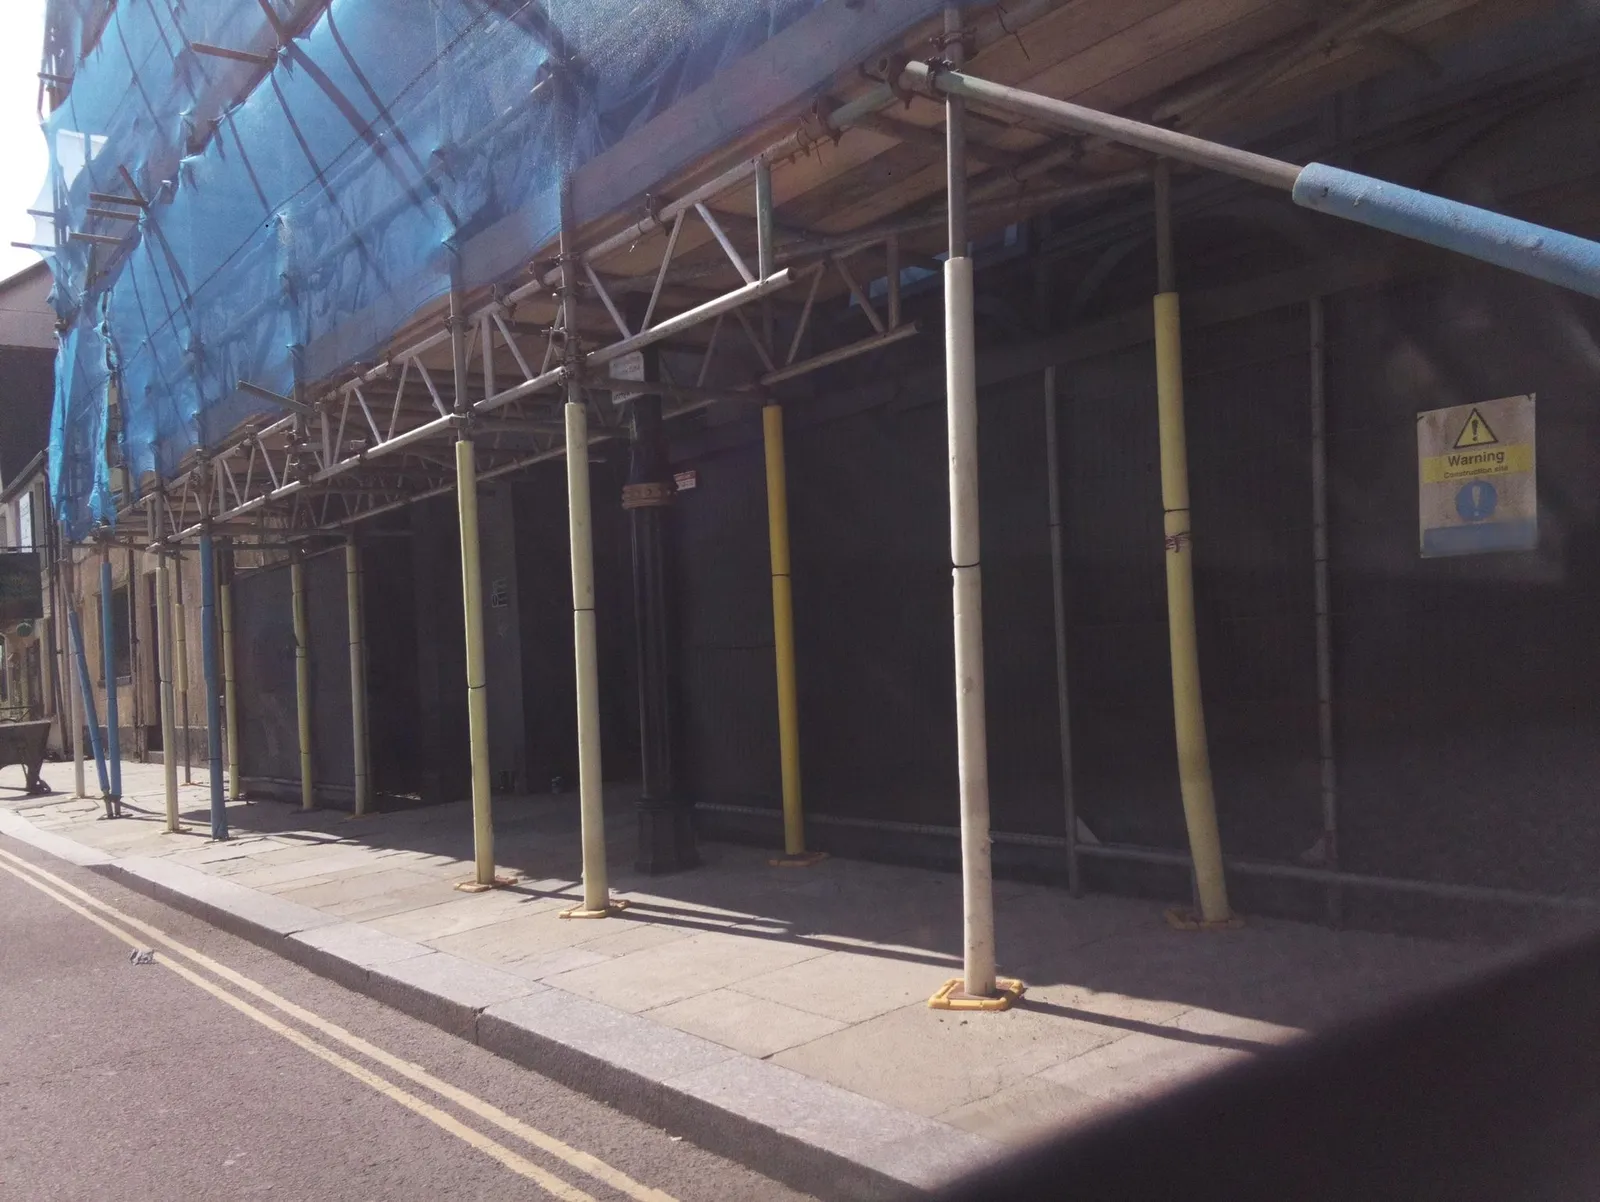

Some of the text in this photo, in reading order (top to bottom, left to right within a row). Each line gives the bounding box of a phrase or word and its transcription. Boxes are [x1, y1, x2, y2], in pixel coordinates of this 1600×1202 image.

[1448, 451, 1505, 467] Warning
[1443, 465, 1508, 479] Construction site
